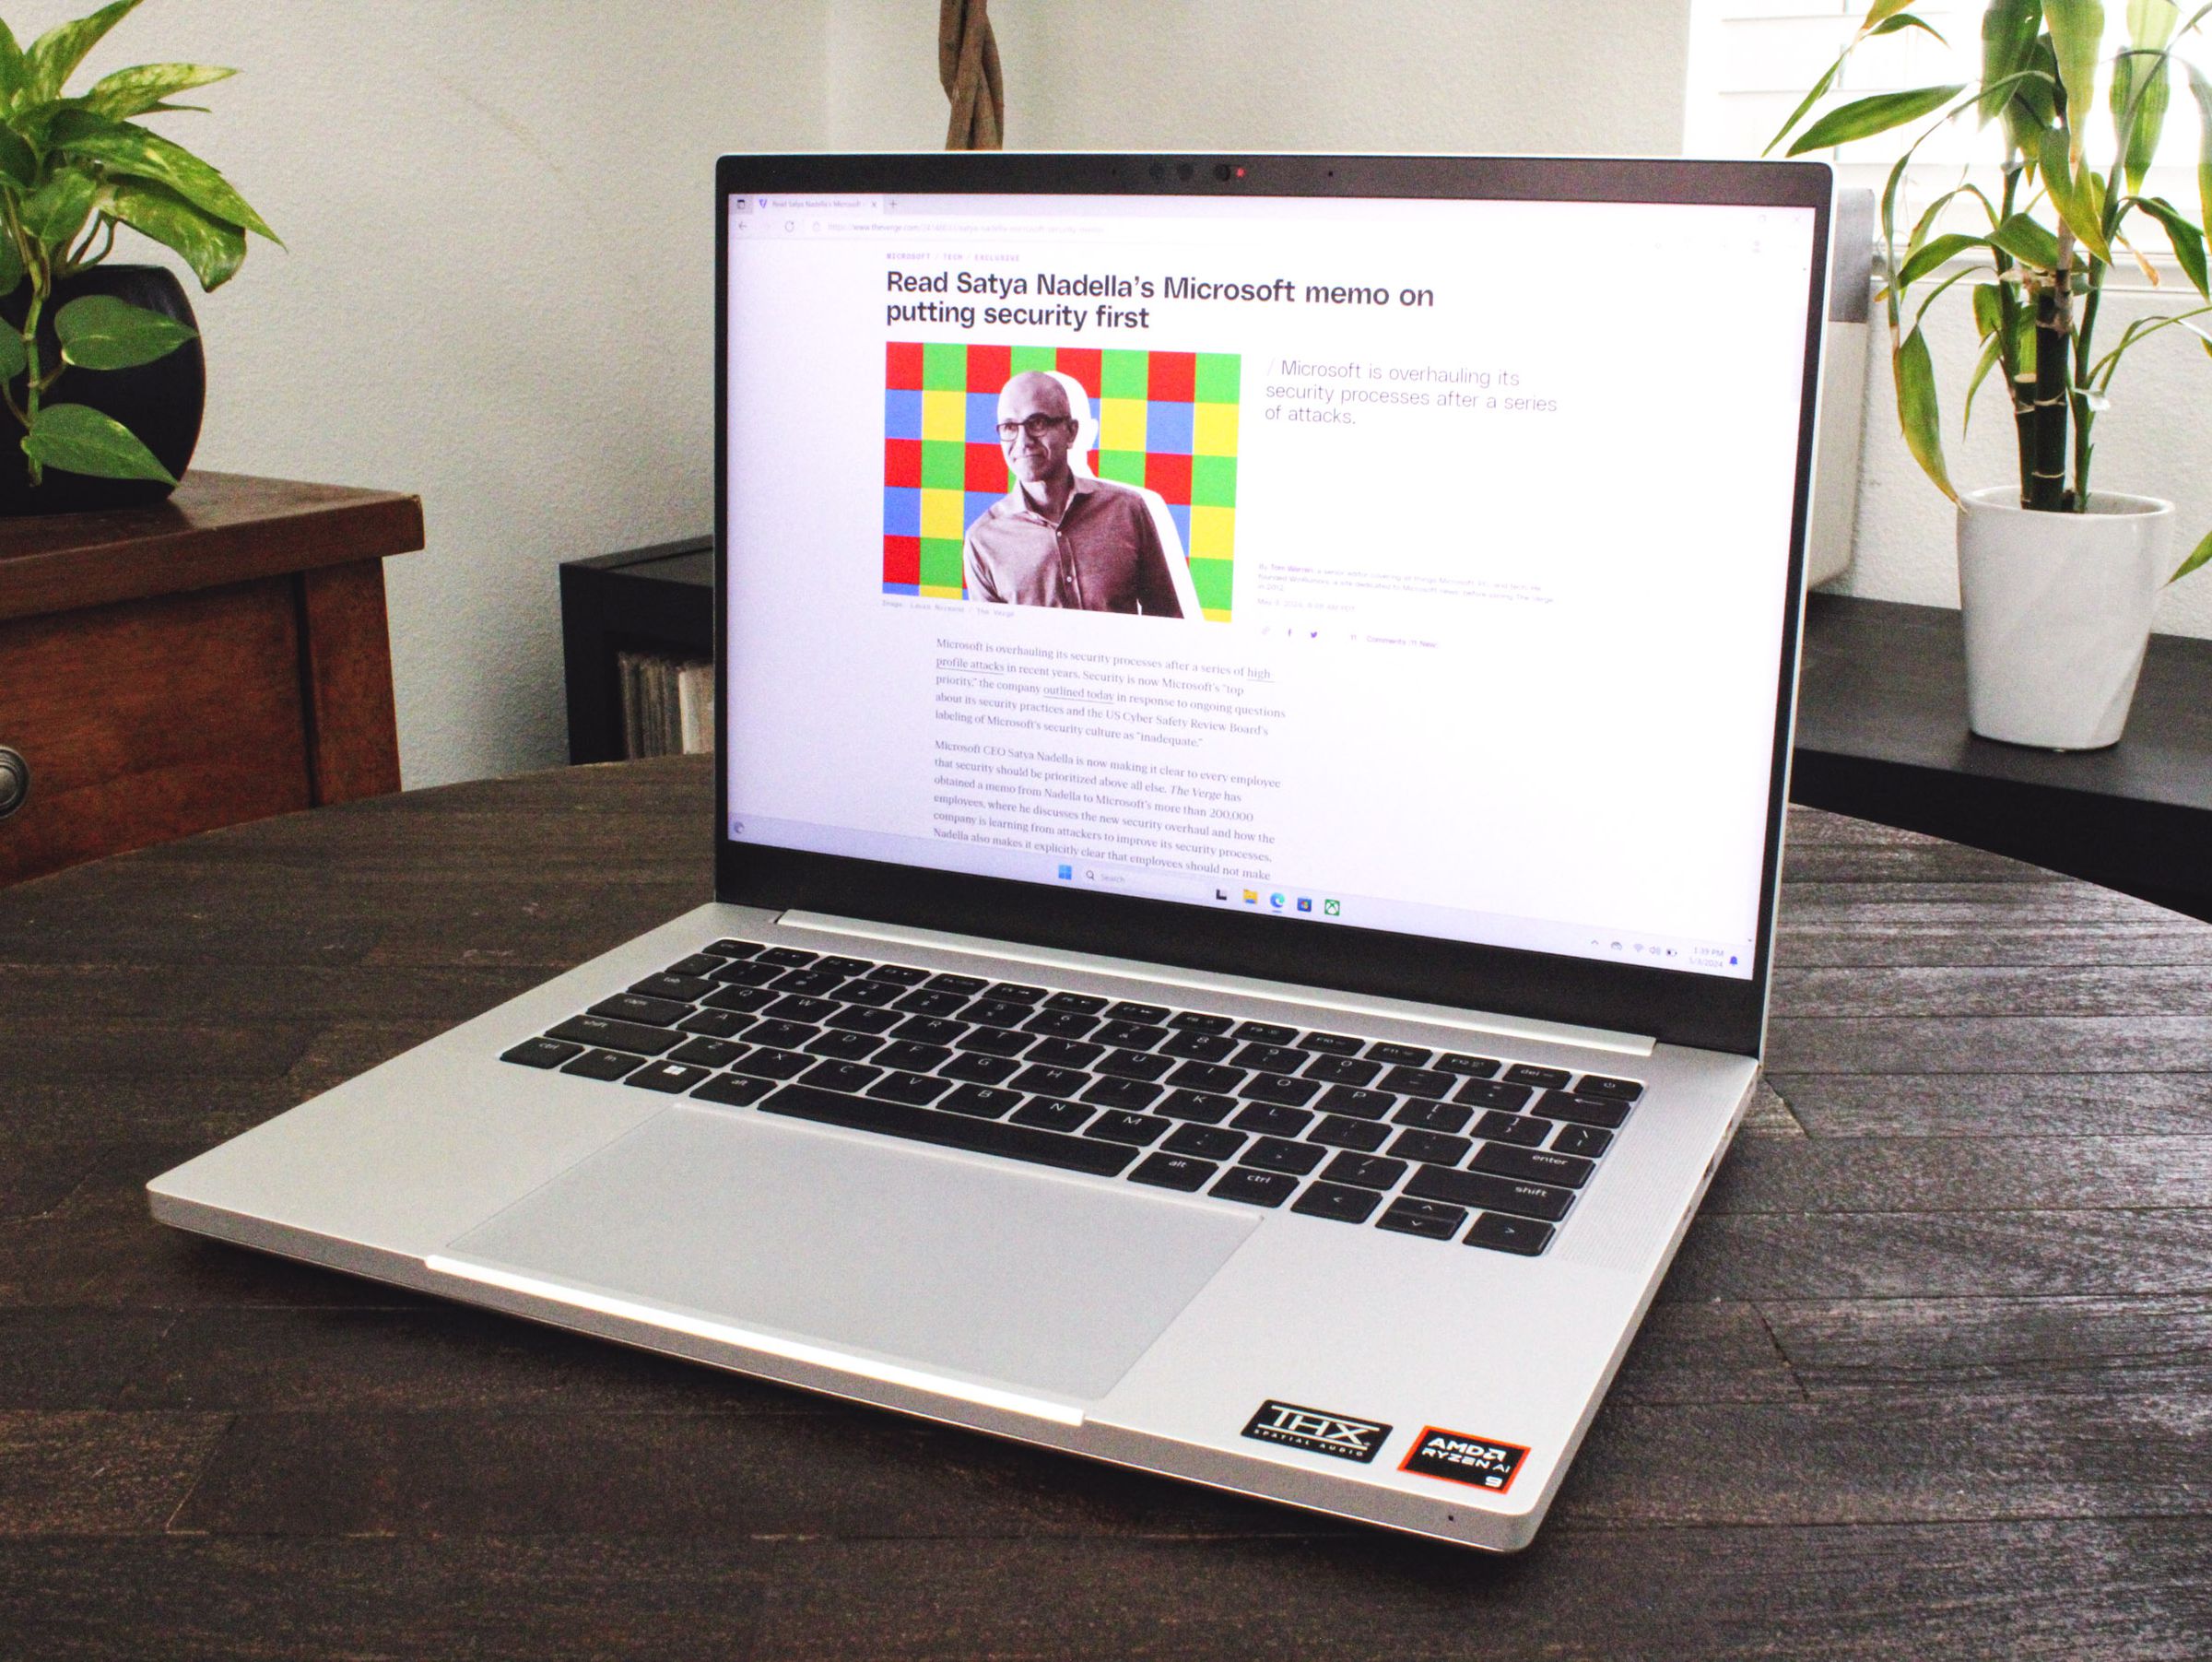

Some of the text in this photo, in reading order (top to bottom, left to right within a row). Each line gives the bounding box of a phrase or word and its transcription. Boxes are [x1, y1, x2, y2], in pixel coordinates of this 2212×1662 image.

[887, 271, 1434, 307] Read Satya Nadella’s Microsoft memo on
[887, 301, 1149, 332] putting security first
[1281, 360, 1520, 389] Microsoft is overhauling its
[1266, 385, 1558, 412] security processes after a series
[1265, 406, 1356, 425] of attacks.
[935, 638, 983, 651] Microsoft
[984, 642, 994, 652] is
[994, 645, 1053, 660] overhauling
[1055, 649, 1068, 659] its
[1069, 653, 1111, 666] security
[1112, 657, 1162, 667] processes
[1164, 659, 1190, 670] after
[1200, 664, 1230, 674] series
[1233, 666, 1244, 675] of
[935, 657, 969, 667] profile
[970, 661, 1005, 671] attacks
[1006, 663, 1017, 672] in
[1018, 666, 1049, 676] recent
[1082, 670, 1124, 685] Security
[1126, 674, 1135, 684] is
[1137, 678, 1159, 686] now
[935, 692, 962, 703] about
[964, 694, 977, 704] its
[978, 699, 1018, 711] security
[1019, 702, 1064, 713] practices
[1065, 706, 1085, 715] and
[1087, 708, 1103, 717] the
[1105, 709, 1121, 719] US
[1122, 711, 1153, 723] Cyber
[1155, 714, 1188, 728] Safety
[1190, 718, 1226, 730] Review
[979, 678, 994, 688] the
[996, 682, 1041, 695] company
[1042, 686, 1084, 697] outlined
[1087, 690, 1113, 702] today
[1116, 691, 1126, 701] in
[1129, 696, 1174, 706] response
[1177, 699, 1187, 707] to
[1189, 701, 1231, 714] ongoing
[1234, 706, 1285, 717] questions
[935, 709, 972, 725] labeling
[973, 713, 986, 723] of
[1042, 724, 1083, 736] security
[1084, 726, 1122, 737] culture
[935, 739, 981, 753] Microsoft
[982, 745, 1006, 756] CEO
[1007, 748, 1034, 760] Satya
[1036, 751, 1074, 763] Nadella
[1076, 755, 1084, 765] is
[1110, 760, 1147, 774] making
[1149, 763, 1157, 773] it
[1159, 765, 1185, 776] clear
[1187, 769, 1198, 778] to
[1199, 772, 1229, 784] every
[1230, 775, 1280, 788] employee
[934, 758, 952, 768] that
[955, 762, 994, 774] security
[995, 765, 1029, 776] should
[1030, 768, 1042, 778] be
[1043, 771, 1097, 784] prioritized
[1099, 777, 1128, 788] above
[1130, 780, 1142, 790] all
[1171, 784, 1189, 796] The
[1191, 787, 1221, 801] Verge
[1223, 791, 1241, 801] has
[933, 774, 975, 787] obtained
[984, 783, 1016, 793] memo
[1017, 784, 1041, 796] from
[1043, 787, 1081, 800] Nadella
[1083, 793, 1093, 802] to
[1154, 804, 1181, 812] more
[1182, 805, 1206, 816] than
[933, 812, 977, 826] company
[978, 816, 986, 825] is
[988, 817, 1029, 832] learning
[1030, 822, 1054, 833] from
[1056, 827, 1101, 840] attackers
[1103, 832, 1114, 842] to
[1116, 833, 1158, 847] improve
[1159, 839, 1172, 849] its
[1174, 843, 1217, 857] security
[987, 800, 1017, 811] where
[1018, 803, 1030, 813] he
[1032, 805, 1079, 819] discusses
[1080, 811, 1097, 821] the
[1099, 816, 1120, 824] new
[1122, 819, 1162, 831] security
[1164, 824, 1209, 835] overhaul
[1211, 829, 1230, 838] and
[1233, 830, 1256, 841] how
[1257, 833, 1275, 843] the
[933, 826, 969, 839] Nadella
[970, 831, 990, 843] also
[992, 835, 1023, 846] makes
[1025, 838, 1031, 848] it
[1033, 842, 1079, 856] explicitly
[1080, 846, 1105, 857] clear
[1107, 850, 1127, 860] that
[1129, 855, 1182, 867] employees
[1185, 860, 1219, 873] should
[1241, 869, 1270, 879] make
[1169, 1160, 1186, 1168] alt
[1532, 1154, 1569, 1166] enter
[1247, 1173, 1272, 1184] ctrl
[1514, 1185, 1547, 1197] shift
[1272, 1406, 1368, 1446] THX
[1254, 1429, 1364, 1457] SPATIAL AUDIO
[1428, 1437, 1485, 1461] AMD
[1422, 1448, 1512, 1474] RYZEN AI
[1484, 1476, 1503, 1488] 9
